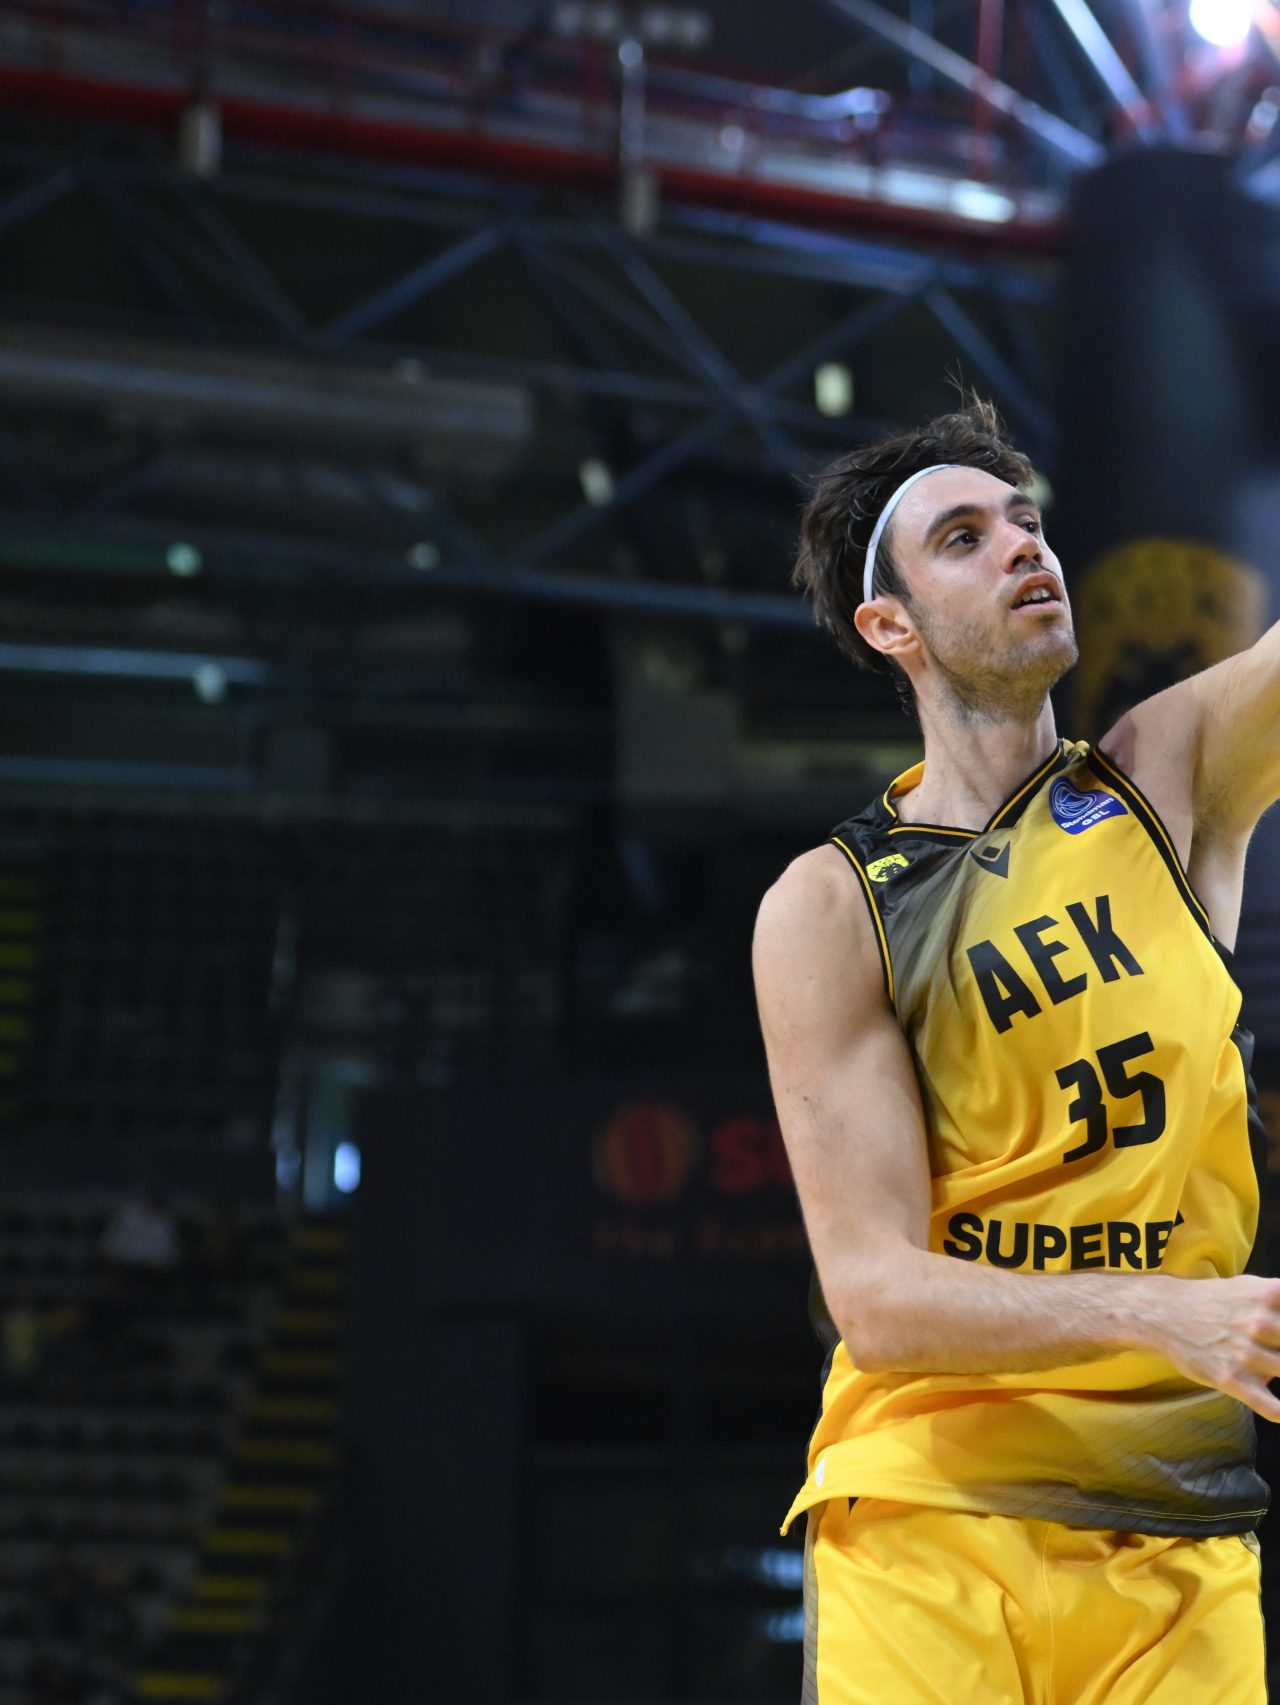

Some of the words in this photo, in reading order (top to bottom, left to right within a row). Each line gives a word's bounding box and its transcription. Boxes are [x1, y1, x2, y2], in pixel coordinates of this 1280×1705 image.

[966, 894, 1144, 1034] AEK
[1055, 1031, 1166, 1164] 35
[943, 1209, 1184, 1270] SUPERB
